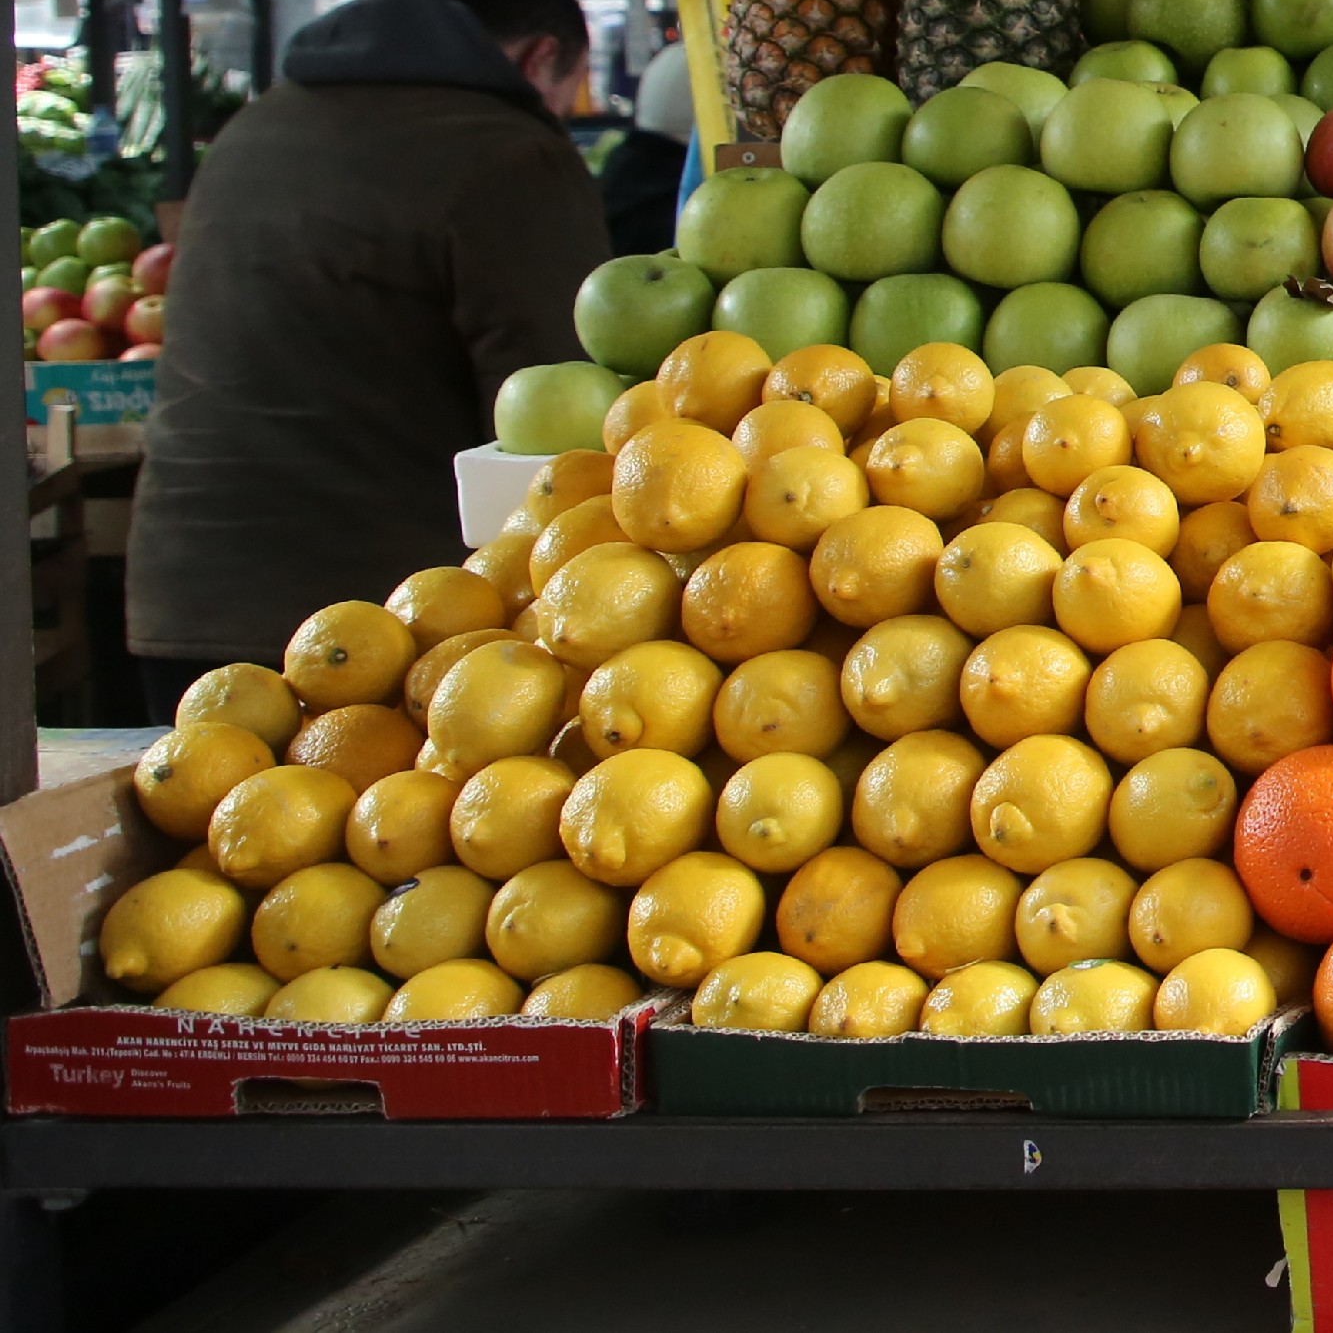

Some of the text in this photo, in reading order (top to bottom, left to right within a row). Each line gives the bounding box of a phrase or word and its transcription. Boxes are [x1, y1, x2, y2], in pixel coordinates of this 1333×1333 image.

[116, 1036, 143, 1045] AKAN
[221, 1039, 249, 1050] SEBZE
[253, 1041, 264, 1050] VE
[267, 1041, 299, 1051] MEYVE
[303, 1042, 326, 1052] GIDA
[402, 1054, 417, 1063] 324
[458, 1054, 539, 1063] www.akancitrus.com
[49, 1063, 125, 1087] Turkey
[131, 1068, 168, 1077] Discover
[167, 1080, 191, 1089] Fruits
